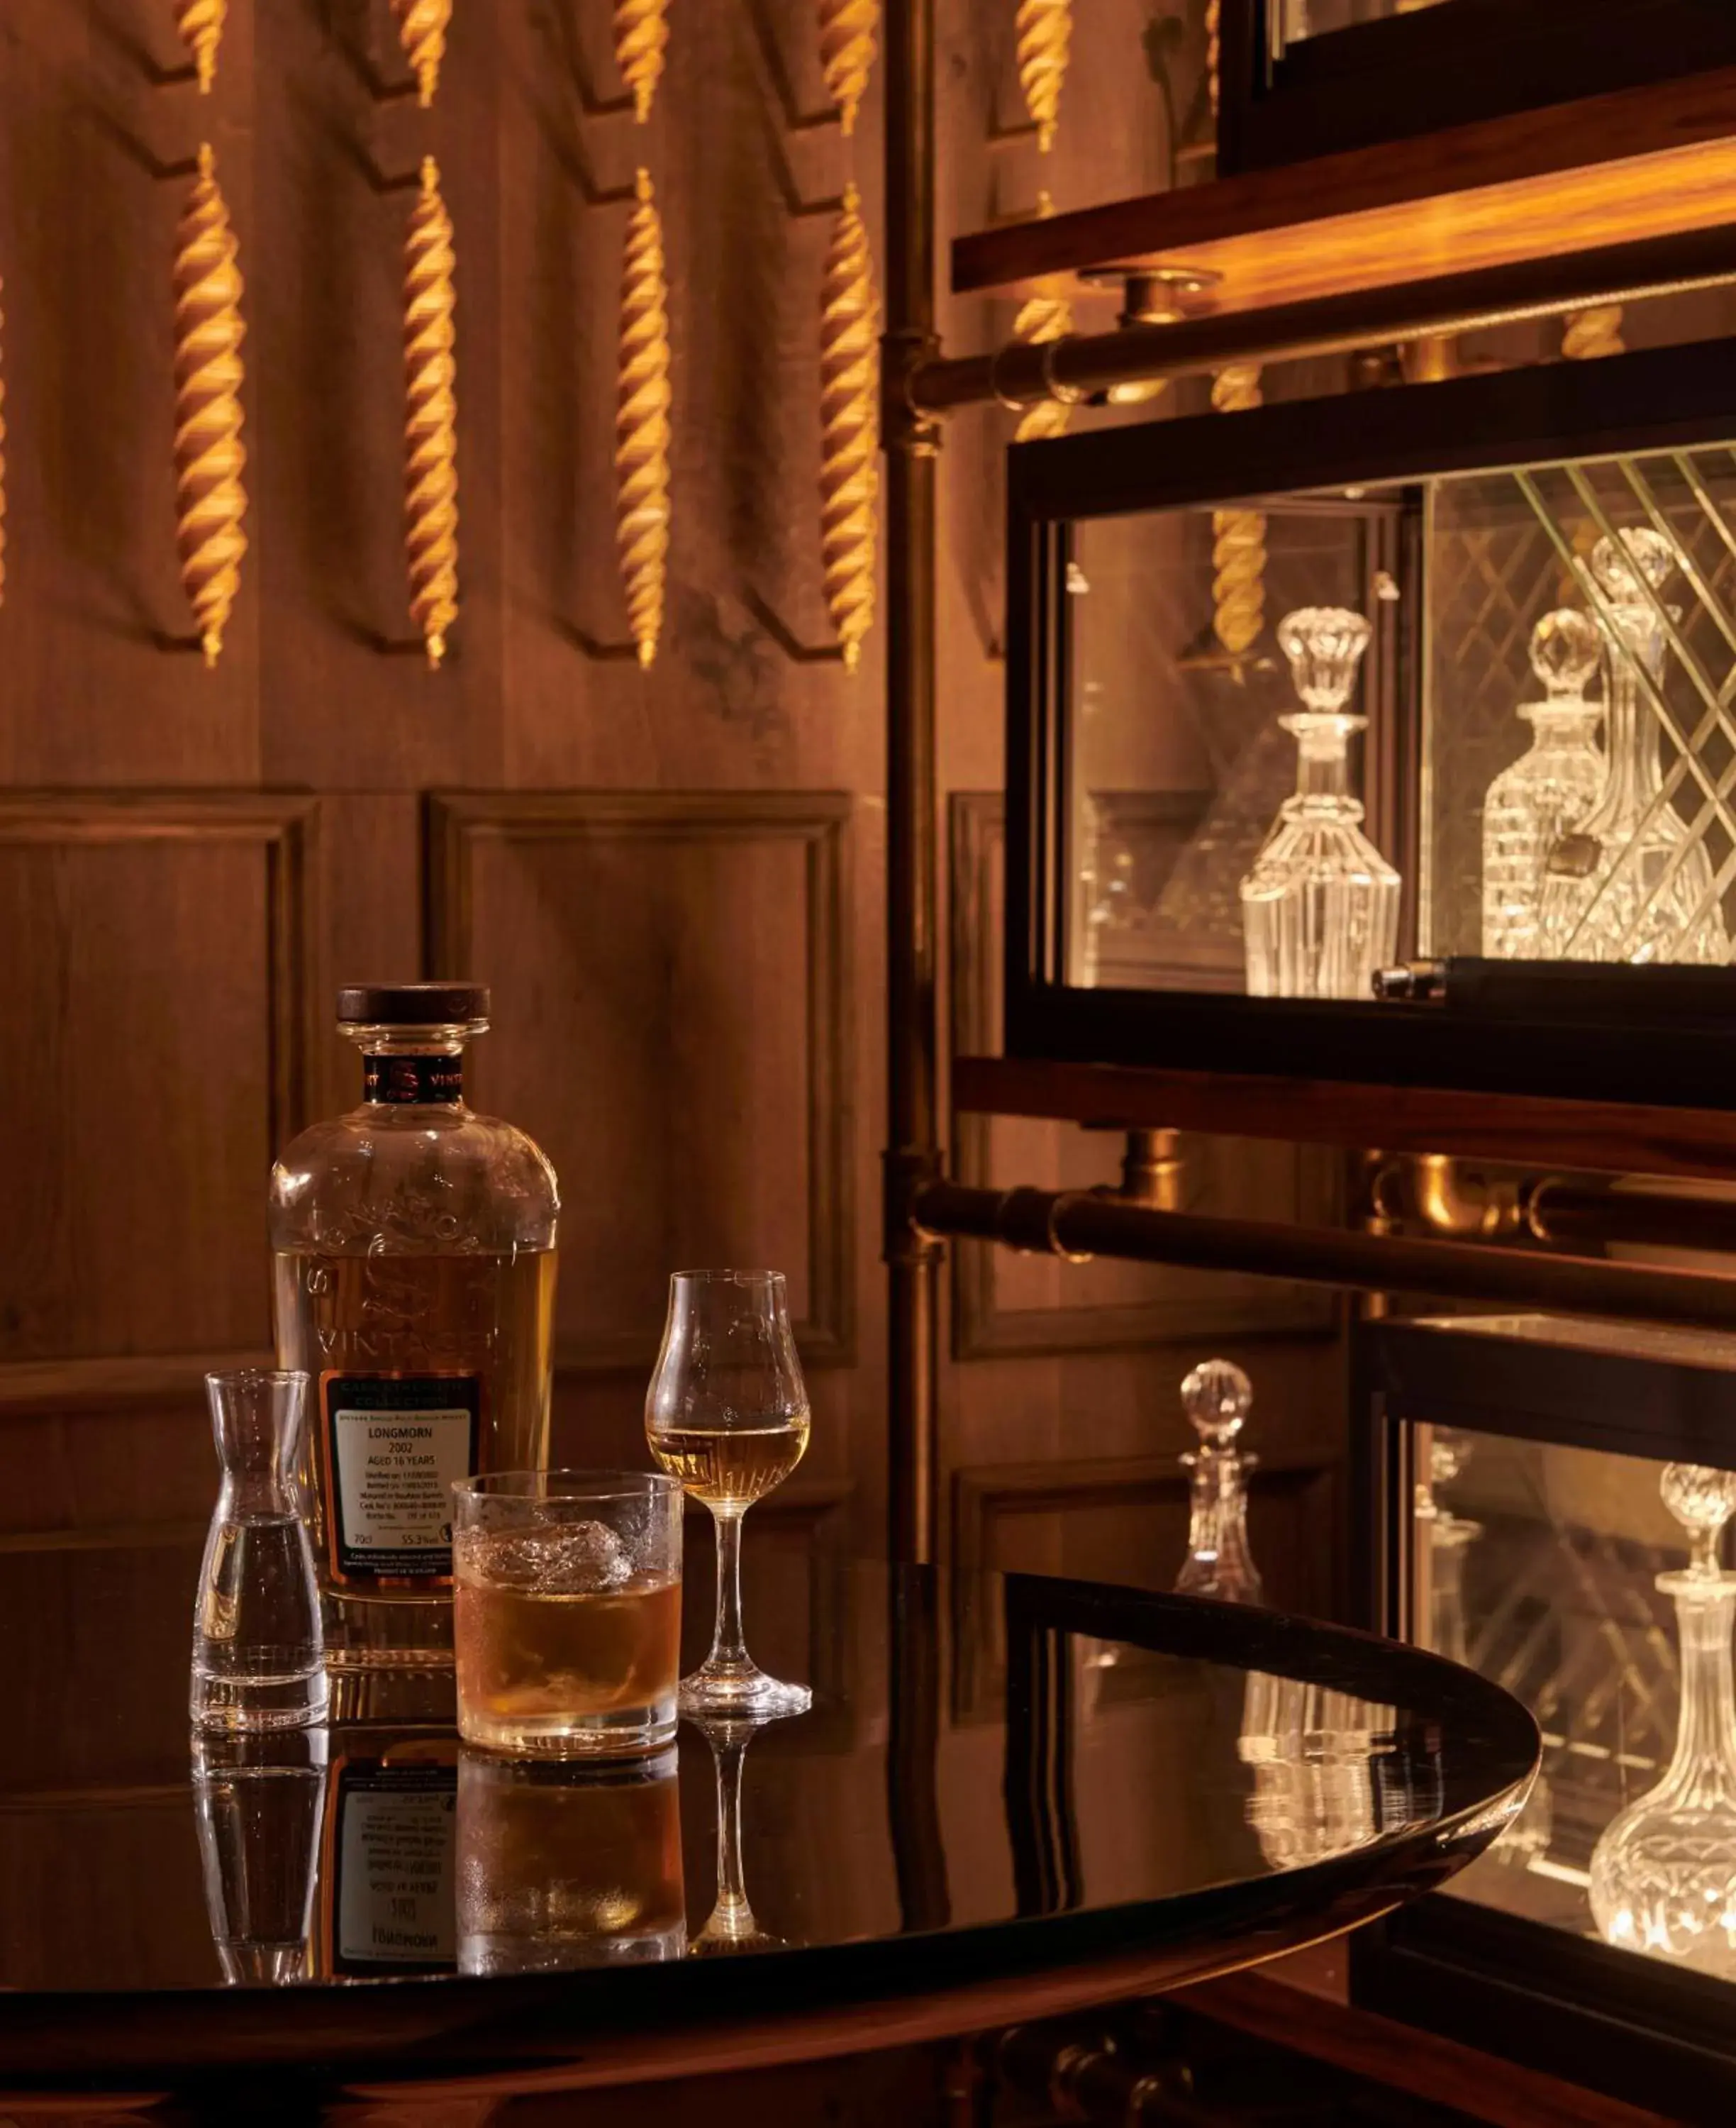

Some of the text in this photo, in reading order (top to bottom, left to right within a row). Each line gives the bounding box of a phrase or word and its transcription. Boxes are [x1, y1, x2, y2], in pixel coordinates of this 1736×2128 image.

[368, 1427, 433, 1439] LONGMORN
[389, 1442, 413, 1454] 2002
[368, 1456, 391, 1465] AGED
[408, 1455, 435, 1465] YEARS
[354, 1534, 372, 1544] 70cl
